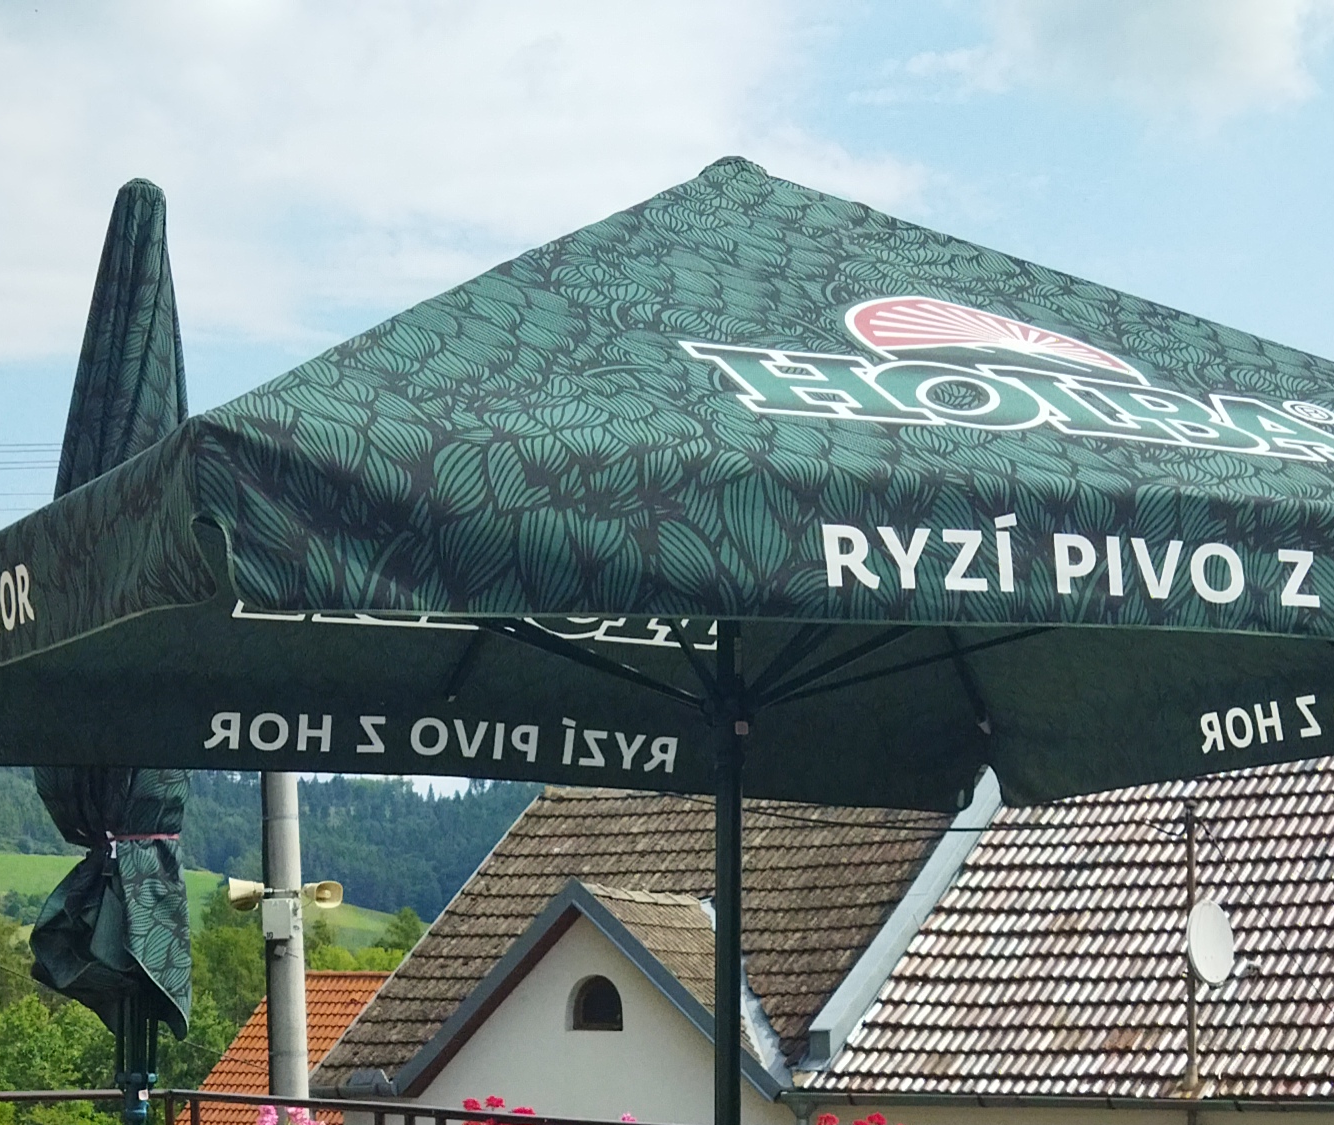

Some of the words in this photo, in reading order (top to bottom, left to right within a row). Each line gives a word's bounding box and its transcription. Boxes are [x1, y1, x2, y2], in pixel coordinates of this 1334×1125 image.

[822, 512, 1017, 593] RYZÍ
[1053, 532, 1245, 604] PIVO
[1278, 549, 1320, 608] Z
